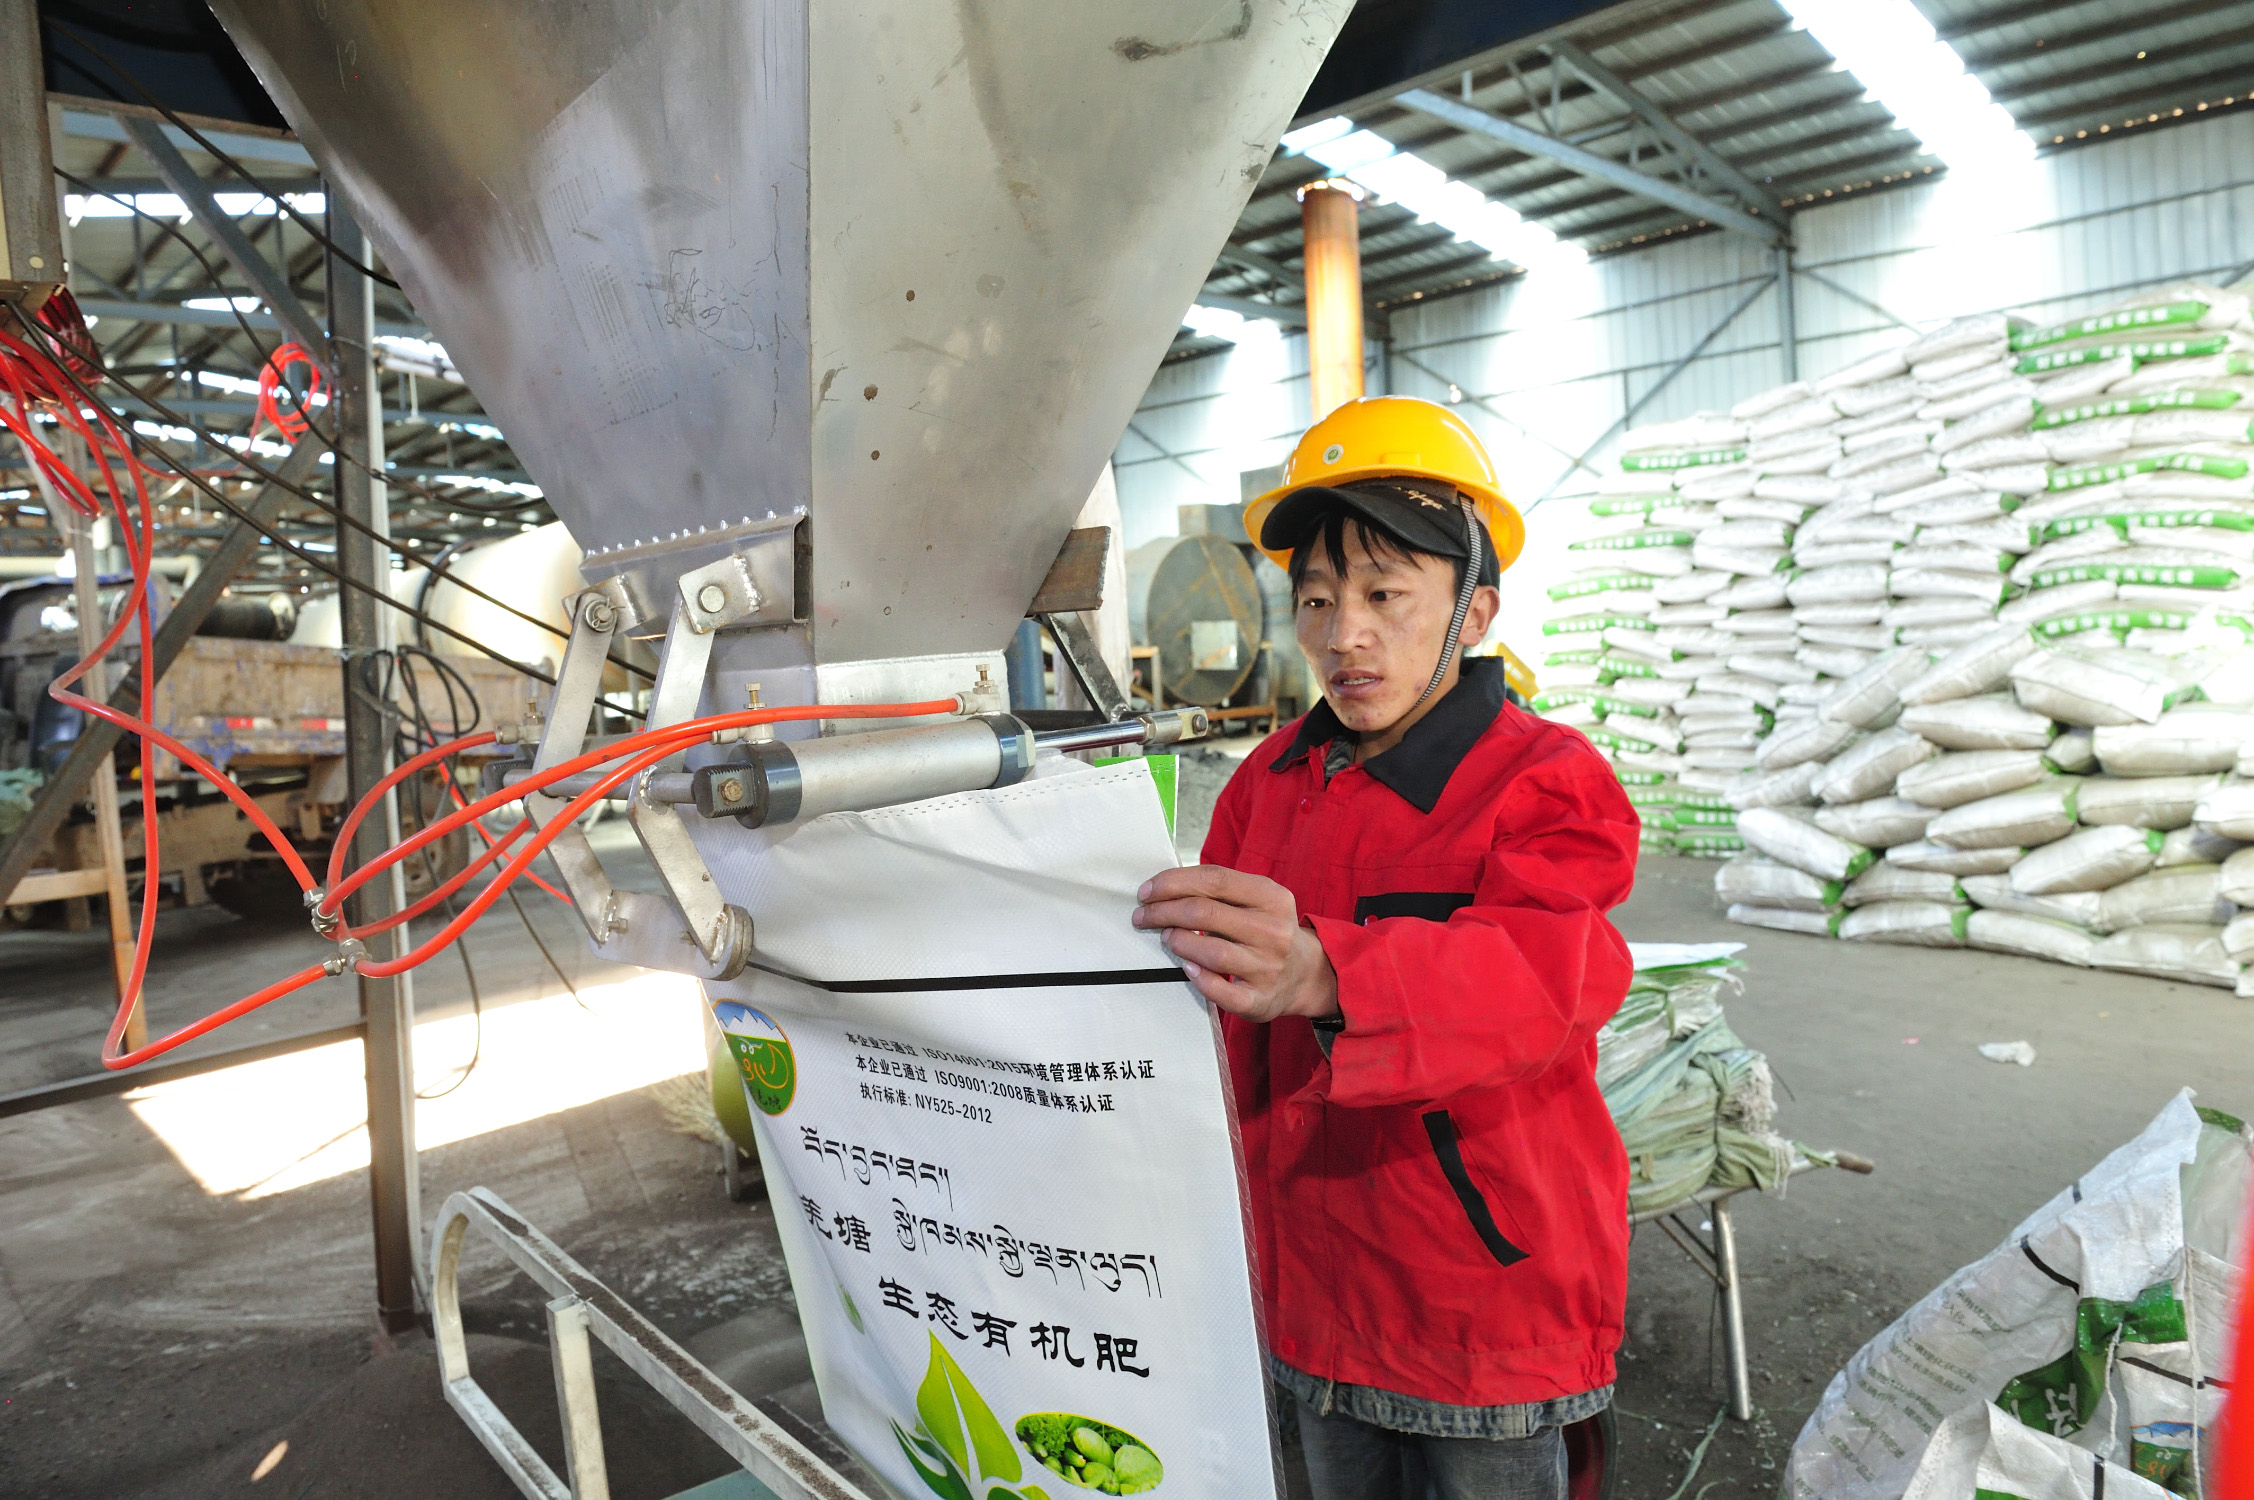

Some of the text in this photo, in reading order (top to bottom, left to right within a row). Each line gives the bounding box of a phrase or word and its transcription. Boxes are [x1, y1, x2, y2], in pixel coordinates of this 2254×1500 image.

[844, 1031, 1156, 1083] 本企业已通过 ISO14001:2015环境管理体系认证
[855, 1053, 1116, 1114] 本企业已通过 ISO9001:2008质量体系认证
[915, 1093, 993, 1124] NY525-2012
[878, 1274, 1150, 1379] 生态有机肥
